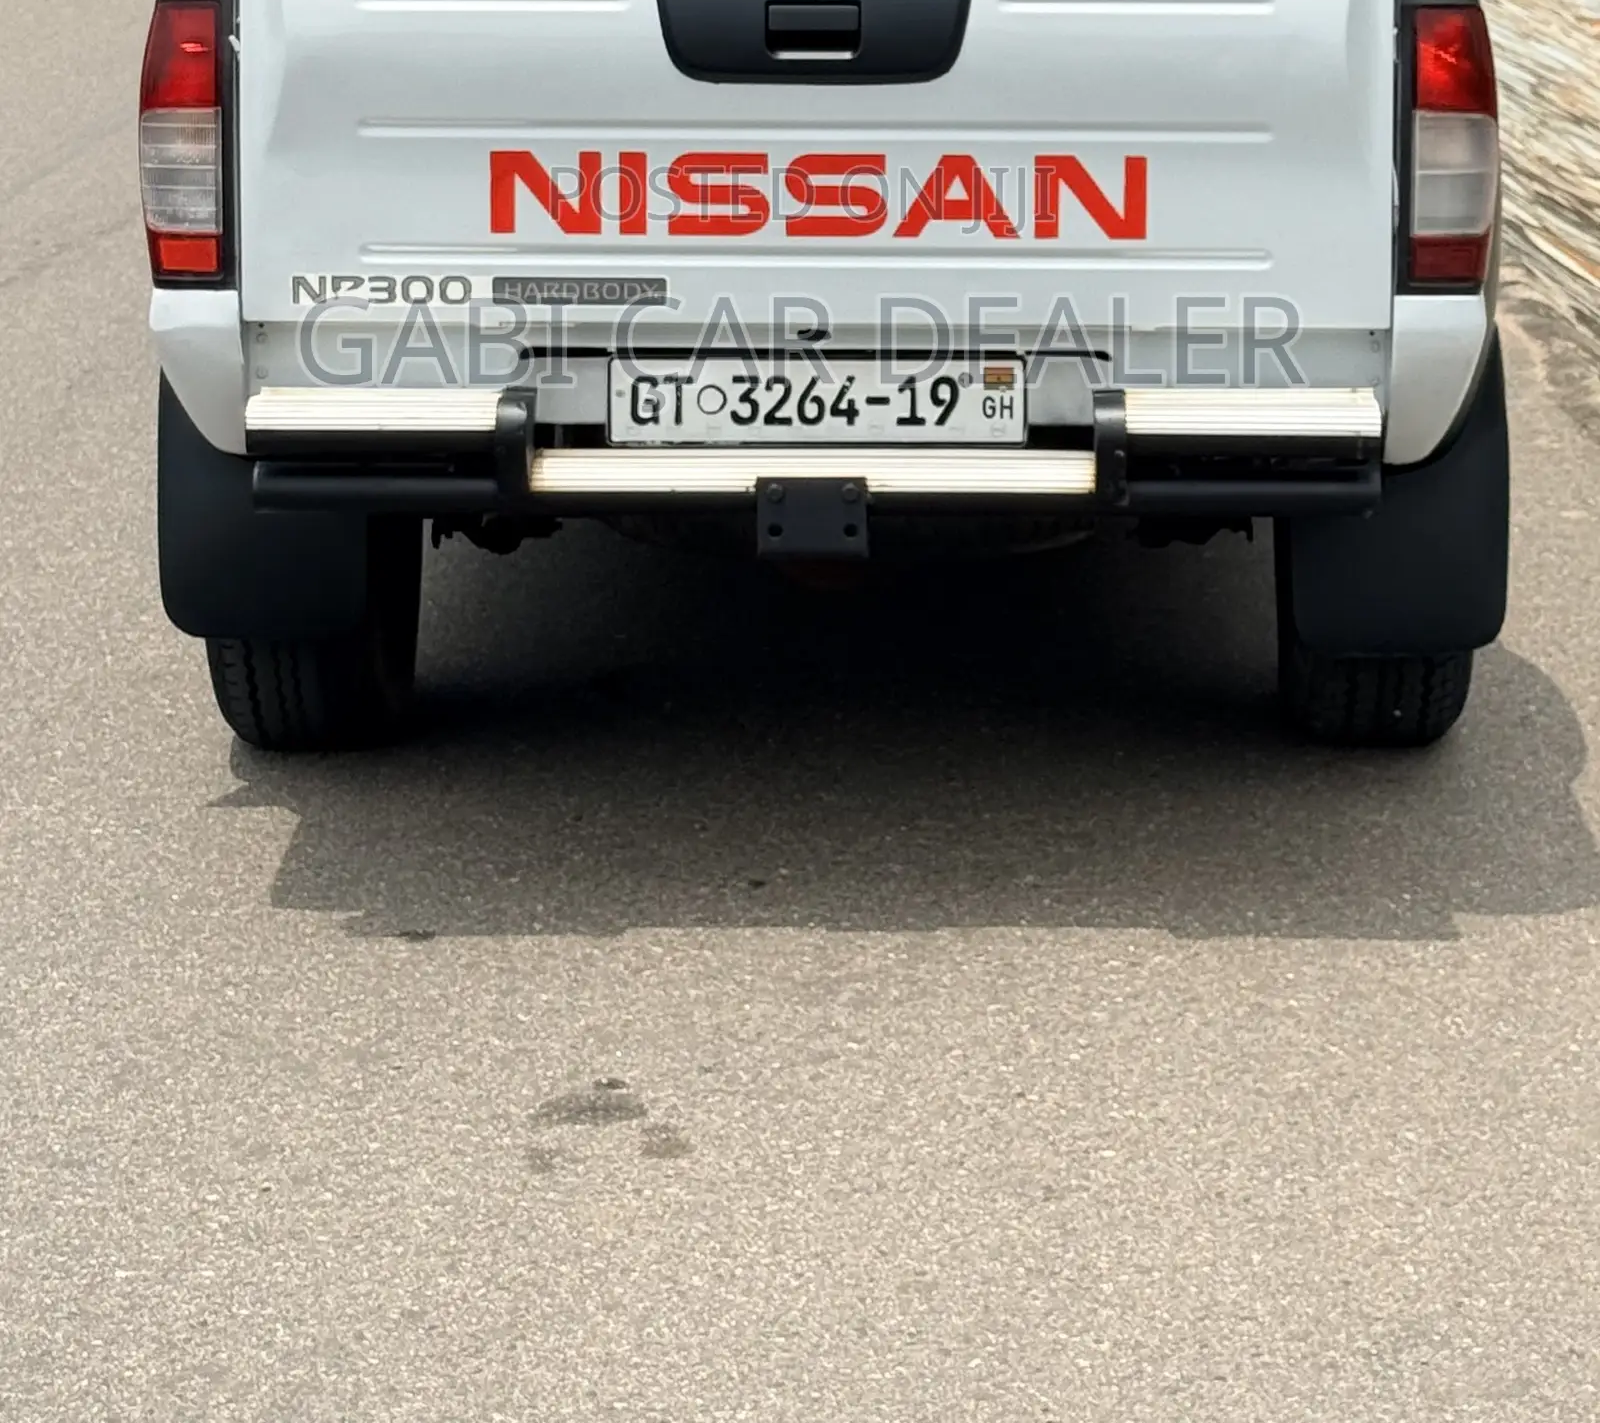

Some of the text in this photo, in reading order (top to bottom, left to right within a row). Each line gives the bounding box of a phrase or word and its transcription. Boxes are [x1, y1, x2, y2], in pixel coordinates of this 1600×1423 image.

[490, 151, 1147, 239] NISSAN
[503, 281, 660, 300] HARDBODY
[629, 374, 1015, 426] GT 3264-19 GH
